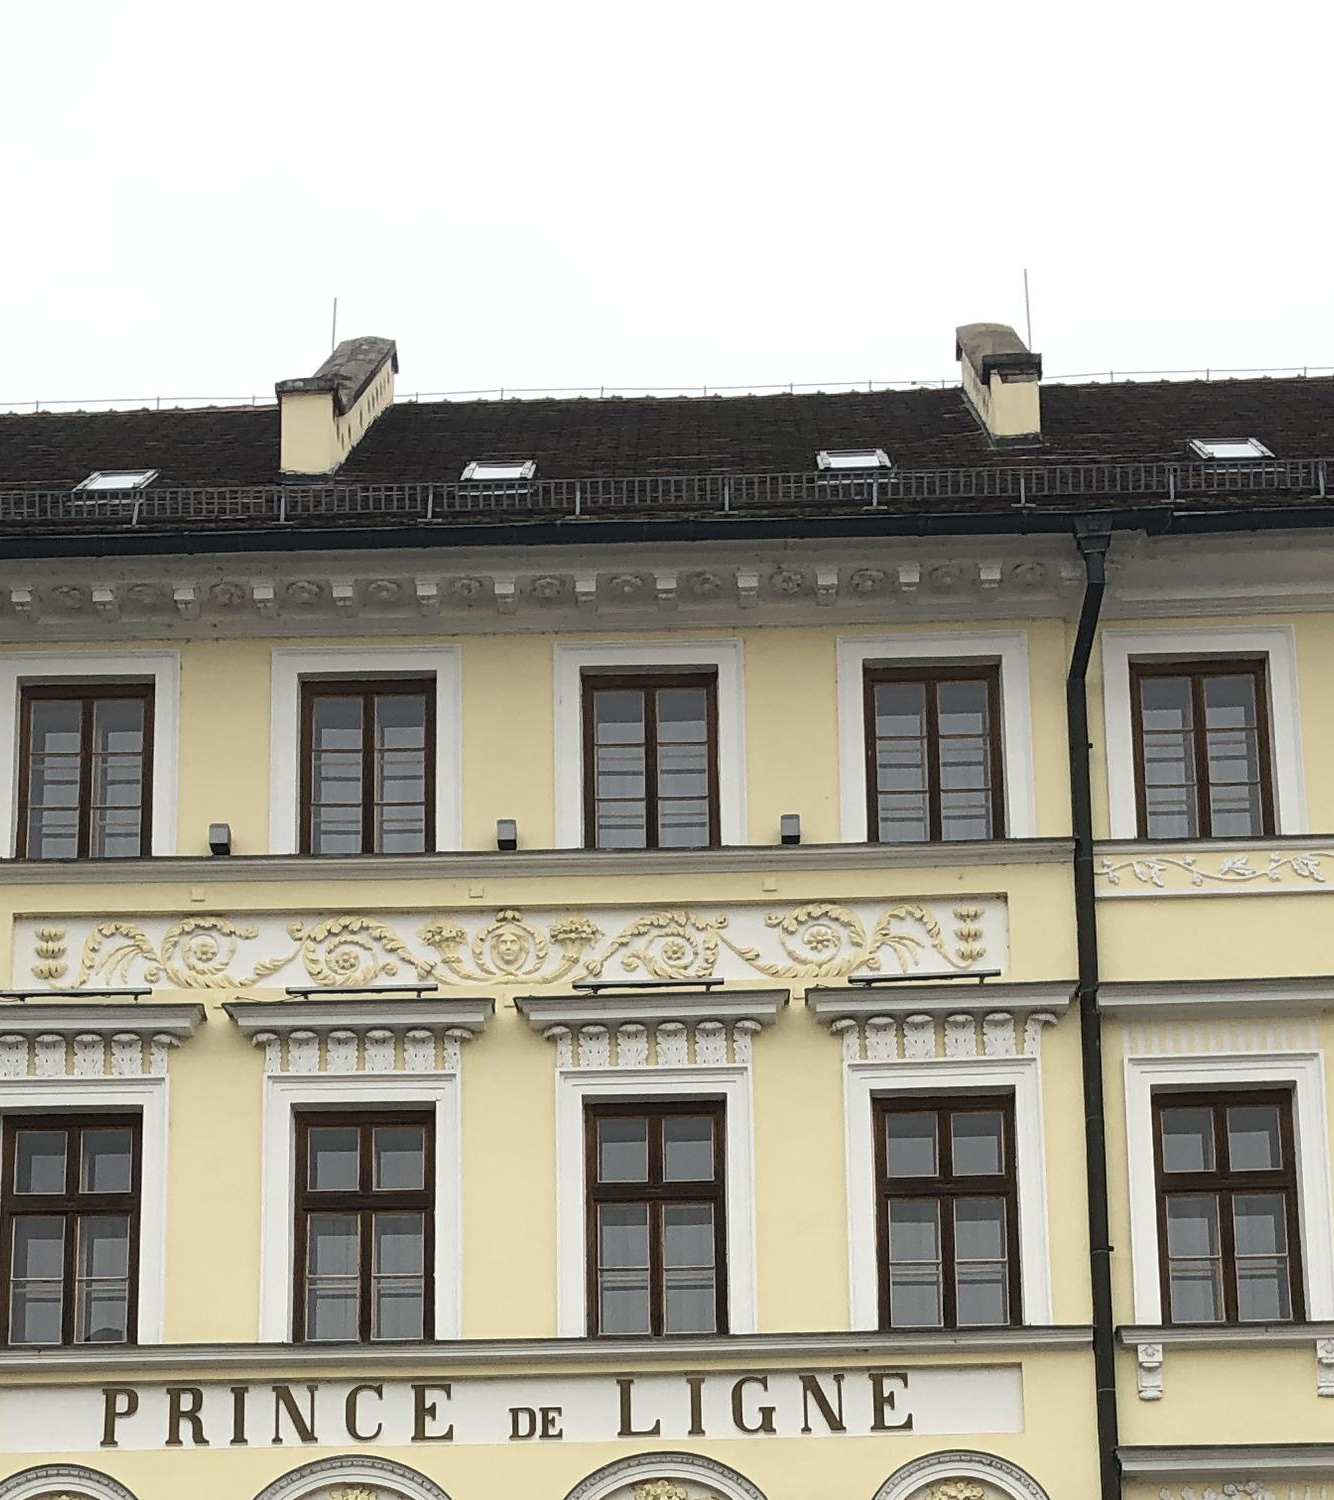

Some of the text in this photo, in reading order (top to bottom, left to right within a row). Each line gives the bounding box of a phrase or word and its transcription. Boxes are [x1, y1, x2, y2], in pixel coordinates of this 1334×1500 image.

[99, 1372, 914, 1446] PRINCE DE LIGNE
